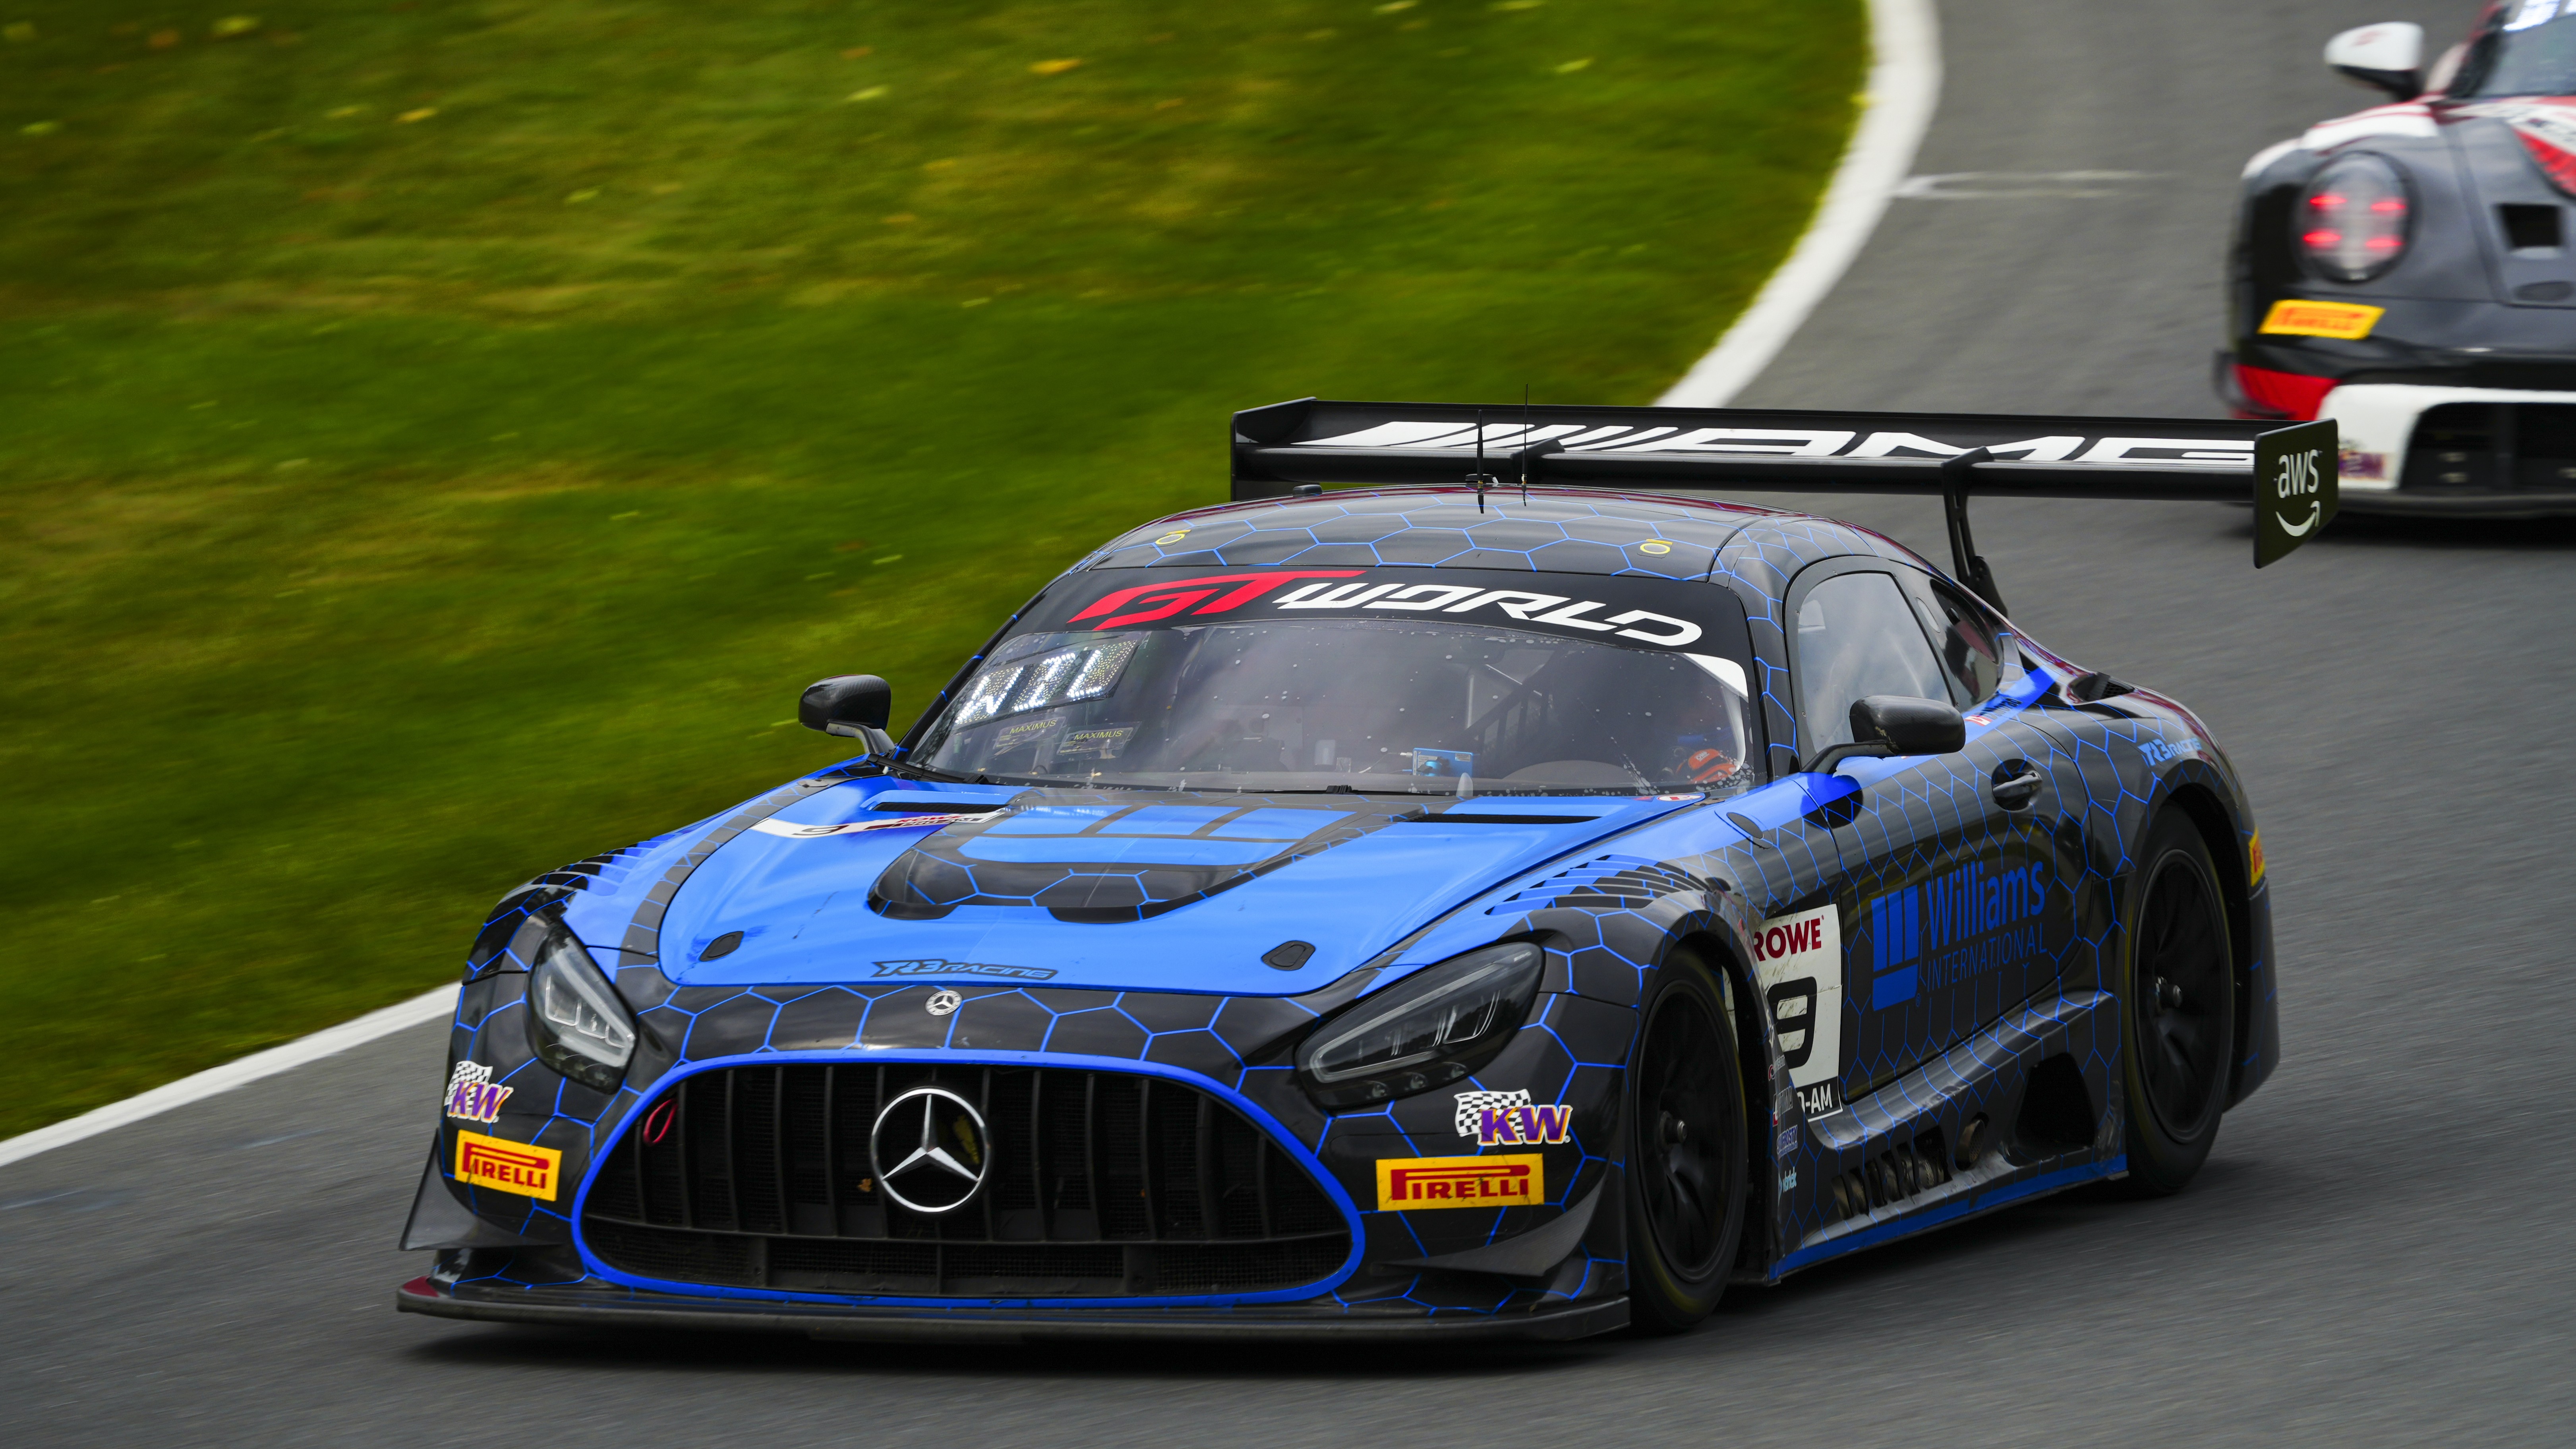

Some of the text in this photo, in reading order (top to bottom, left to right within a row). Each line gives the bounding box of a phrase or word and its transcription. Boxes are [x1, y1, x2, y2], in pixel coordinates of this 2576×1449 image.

[1602, 428, 2255, 466] AMG
[2278, 449, 2319, 499] aws
[1067, 570, 1702, 646] GT WORLD
[1010, 719, 1057, 734] MAXIMUS
[1073, 730, 1123, 741] MAXIMUS
[1925, 861, 2045, 951] Williams
[939, 964, 1055, 979] RACING
[1927, 922, 2047, 992] INTERNATIONAL
[447, 1080, 513, 1123] KW
[1478, 1105, 1572, 1145] KW
[462, 1141, 550, 1189] PIRELLI
[1390, 1164, 1531, 1201] PIRELLI
